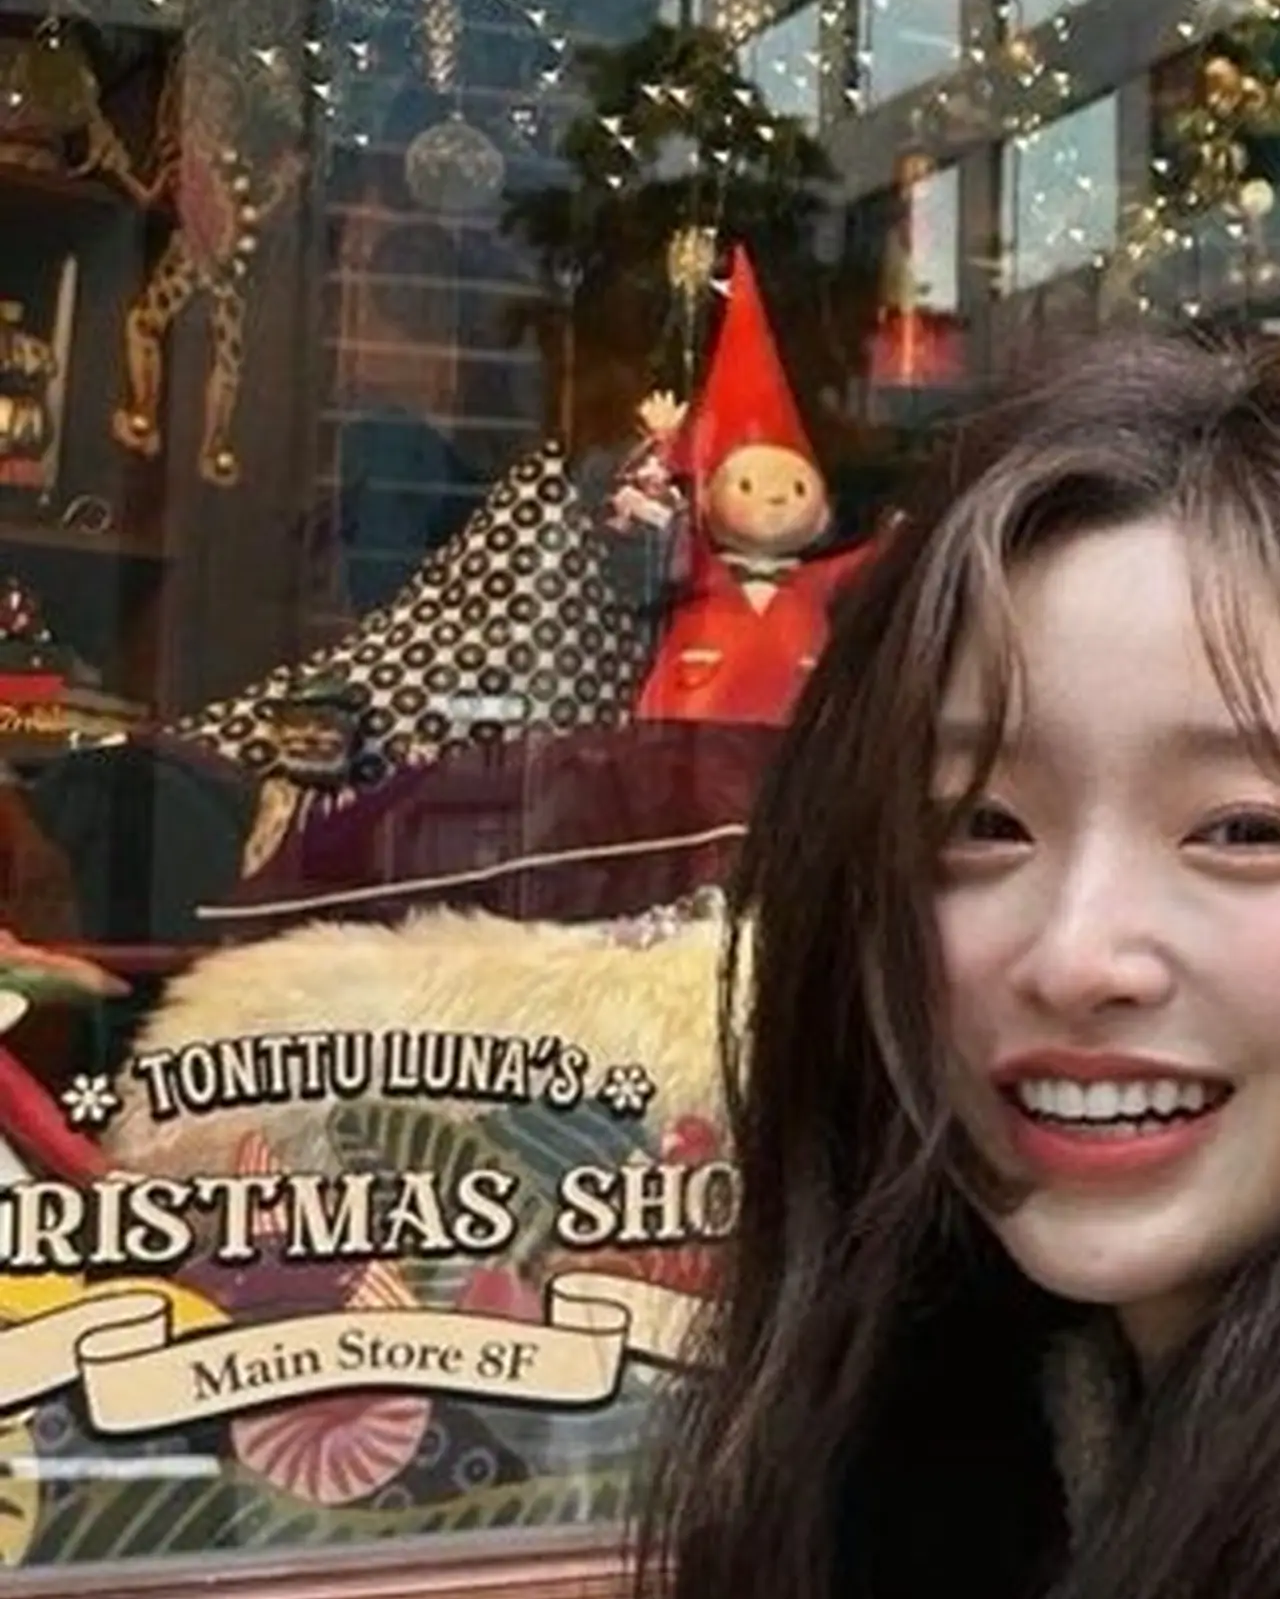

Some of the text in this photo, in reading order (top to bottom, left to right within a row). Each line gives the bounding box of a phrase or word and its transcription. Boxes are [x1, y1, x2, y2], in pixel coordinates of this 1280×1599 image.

[137, 1030, 368, 1116] TONTTU
[0, 1172, 518, 1265] RISTMAS
[188, 1329, 540, 1400] Main Store 8F
